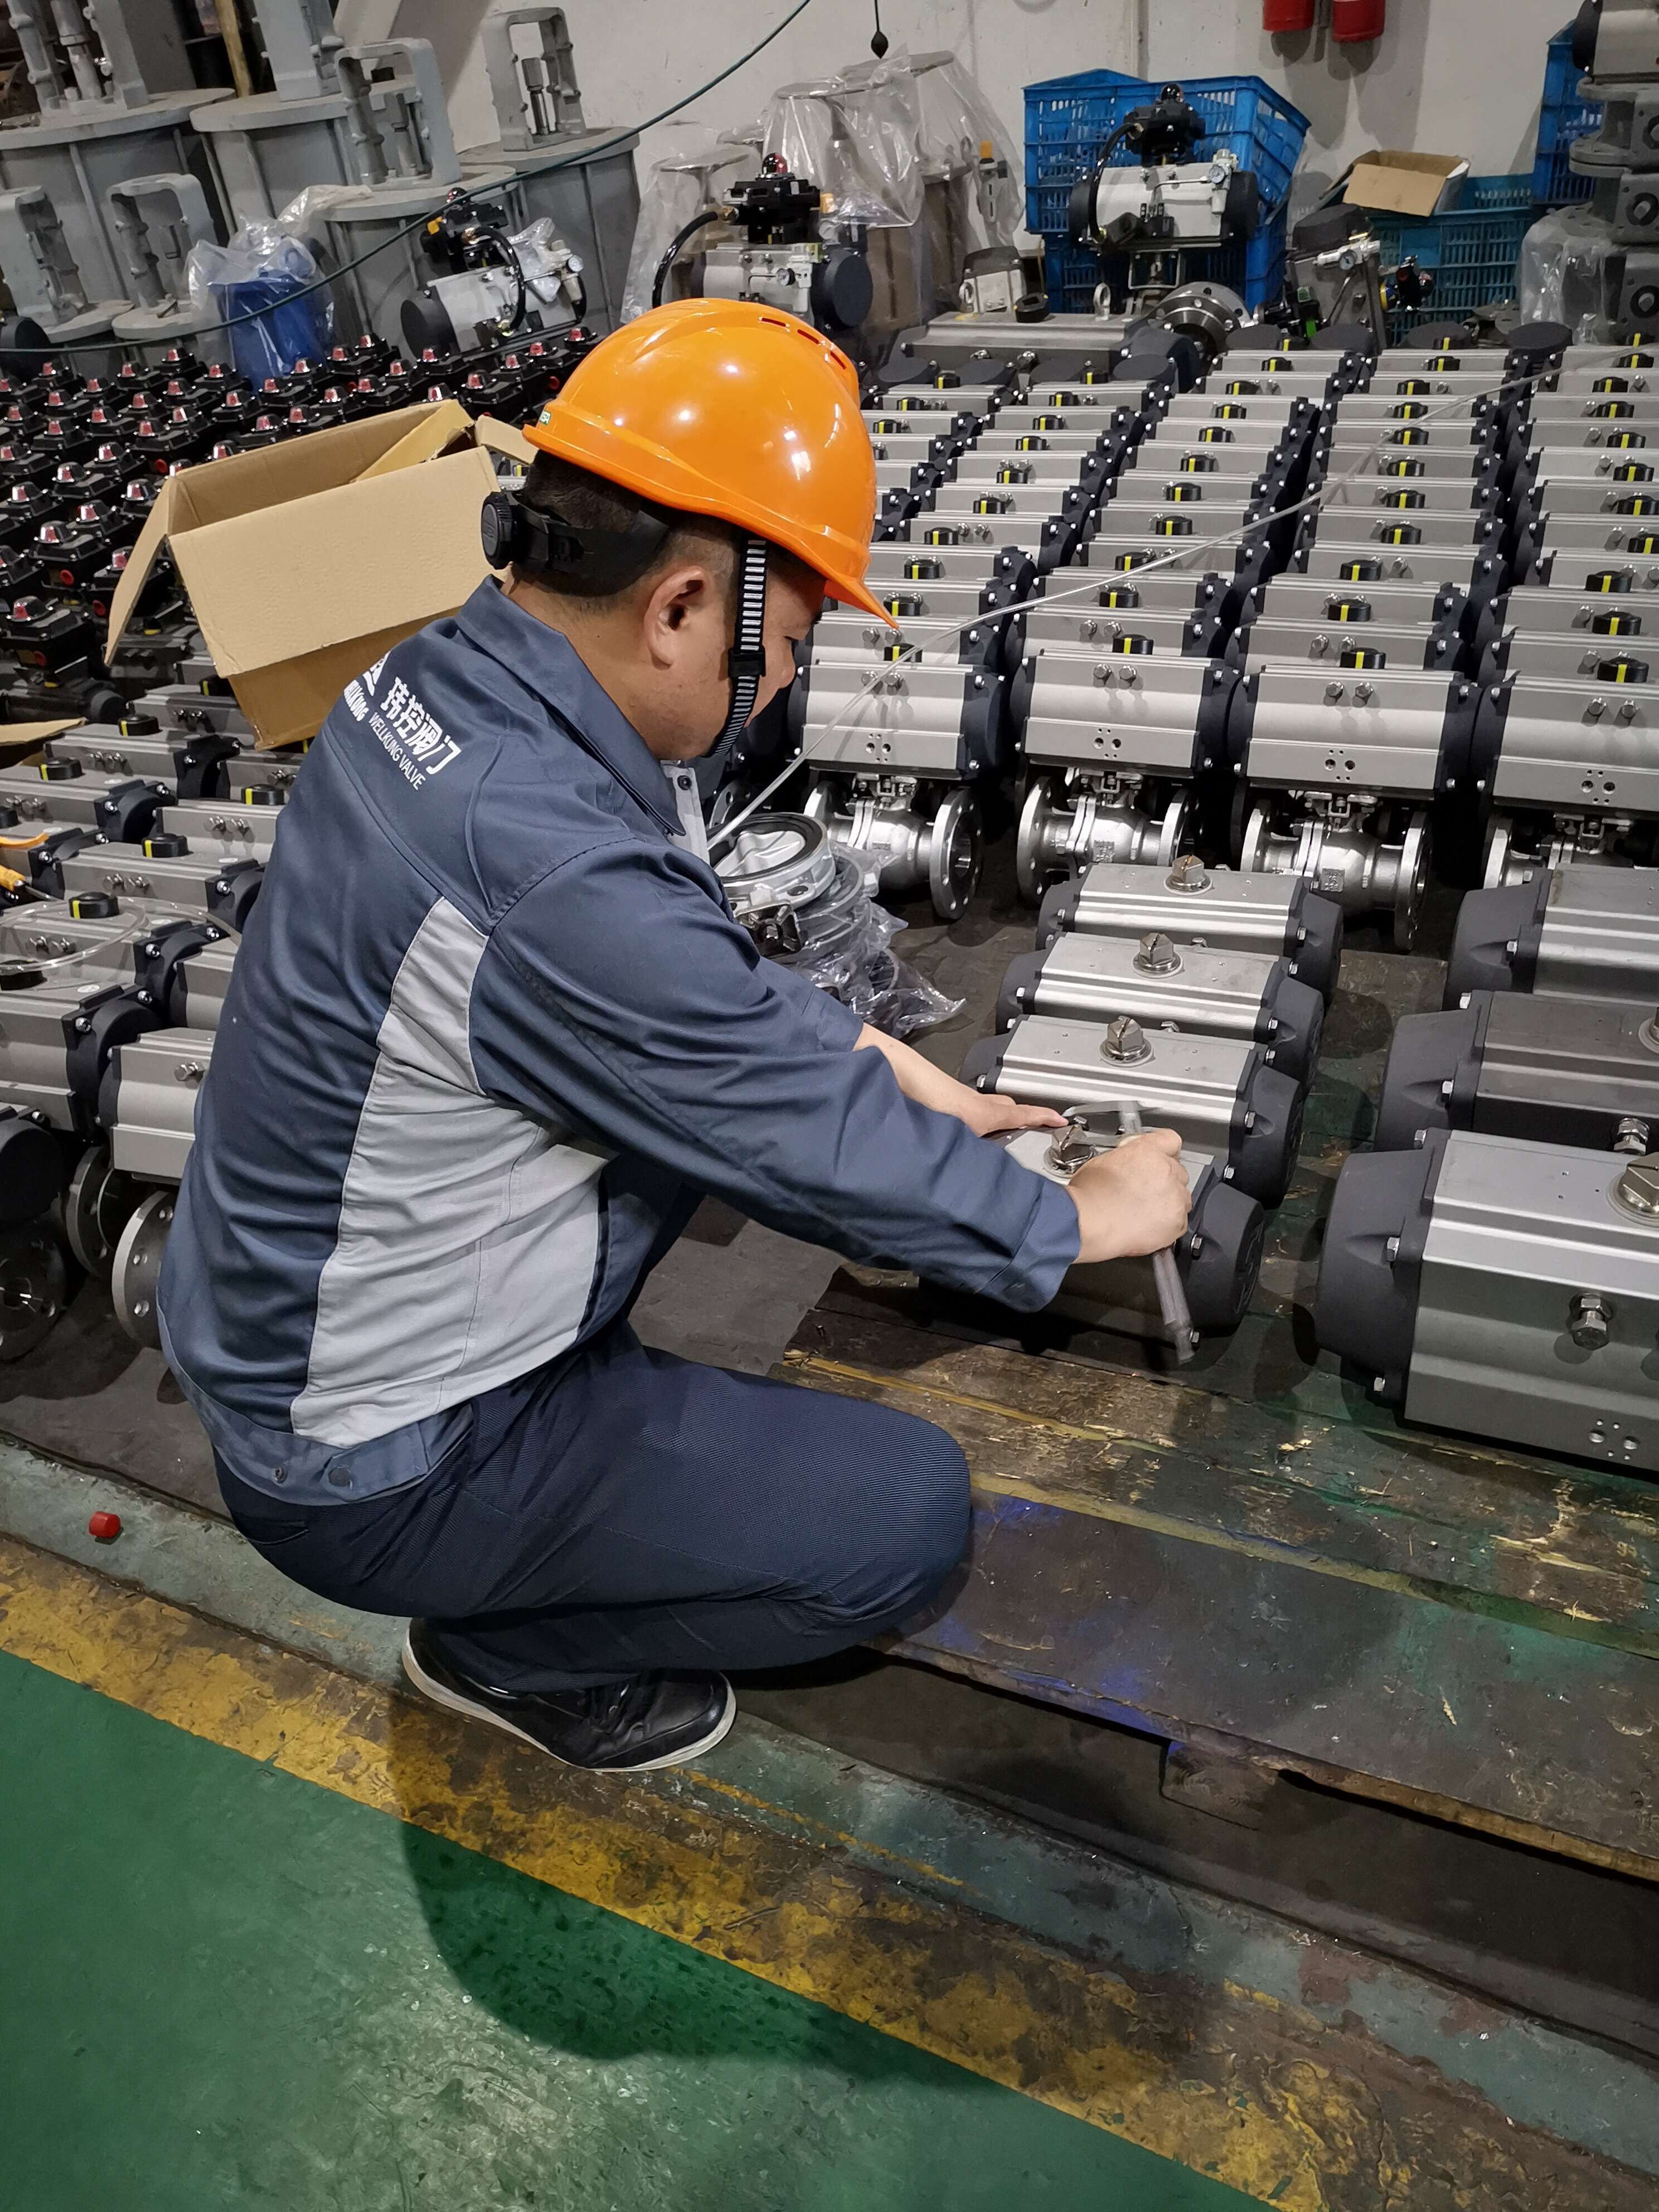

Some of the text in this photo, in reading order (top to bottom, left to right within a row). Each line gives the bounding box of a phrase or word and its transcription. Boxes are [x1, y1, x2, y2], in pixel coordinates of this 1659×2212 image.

[368, 712, 426, 790] WELLKUNG VALVE
[380, 676, 462, 775] 玮控阀门
